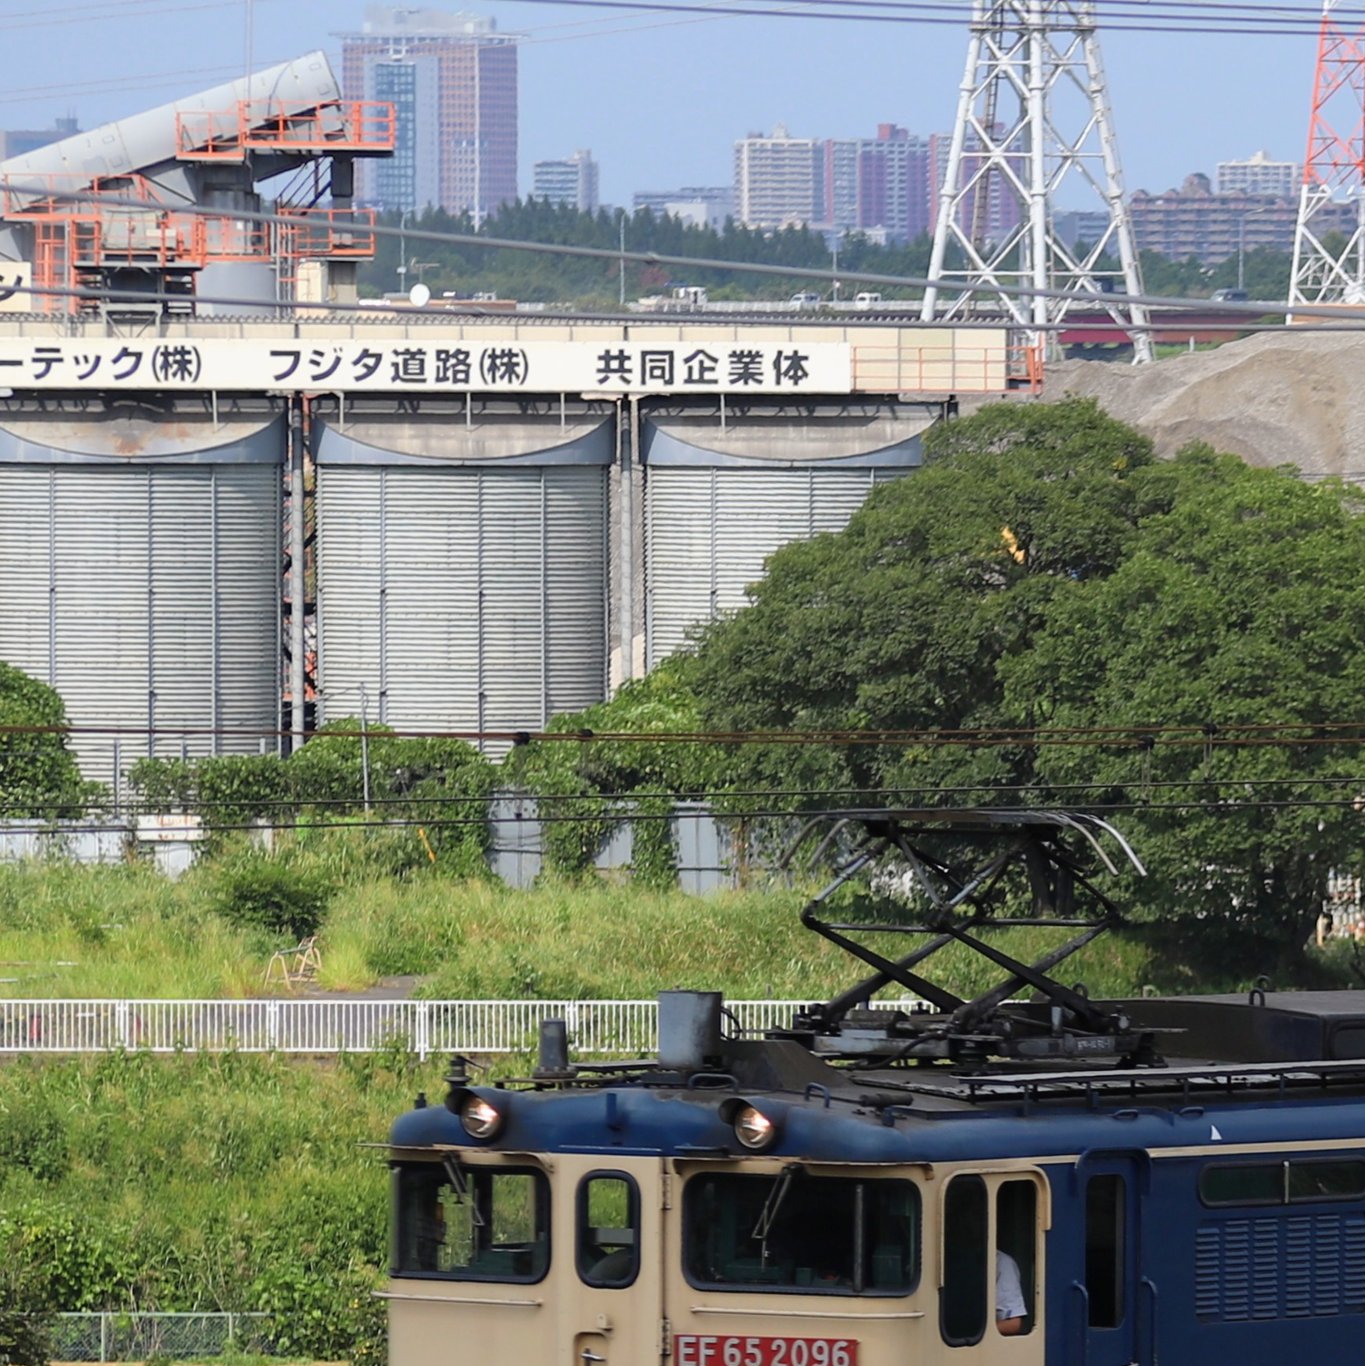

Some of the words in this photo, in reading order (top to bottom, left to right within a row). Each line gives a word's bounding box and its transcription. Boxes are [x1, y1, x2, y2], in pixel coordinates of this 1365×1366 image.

[269, 347, 529, 385] フジタ道路(株)
[596, 349, 809, 386] 共同企業体
